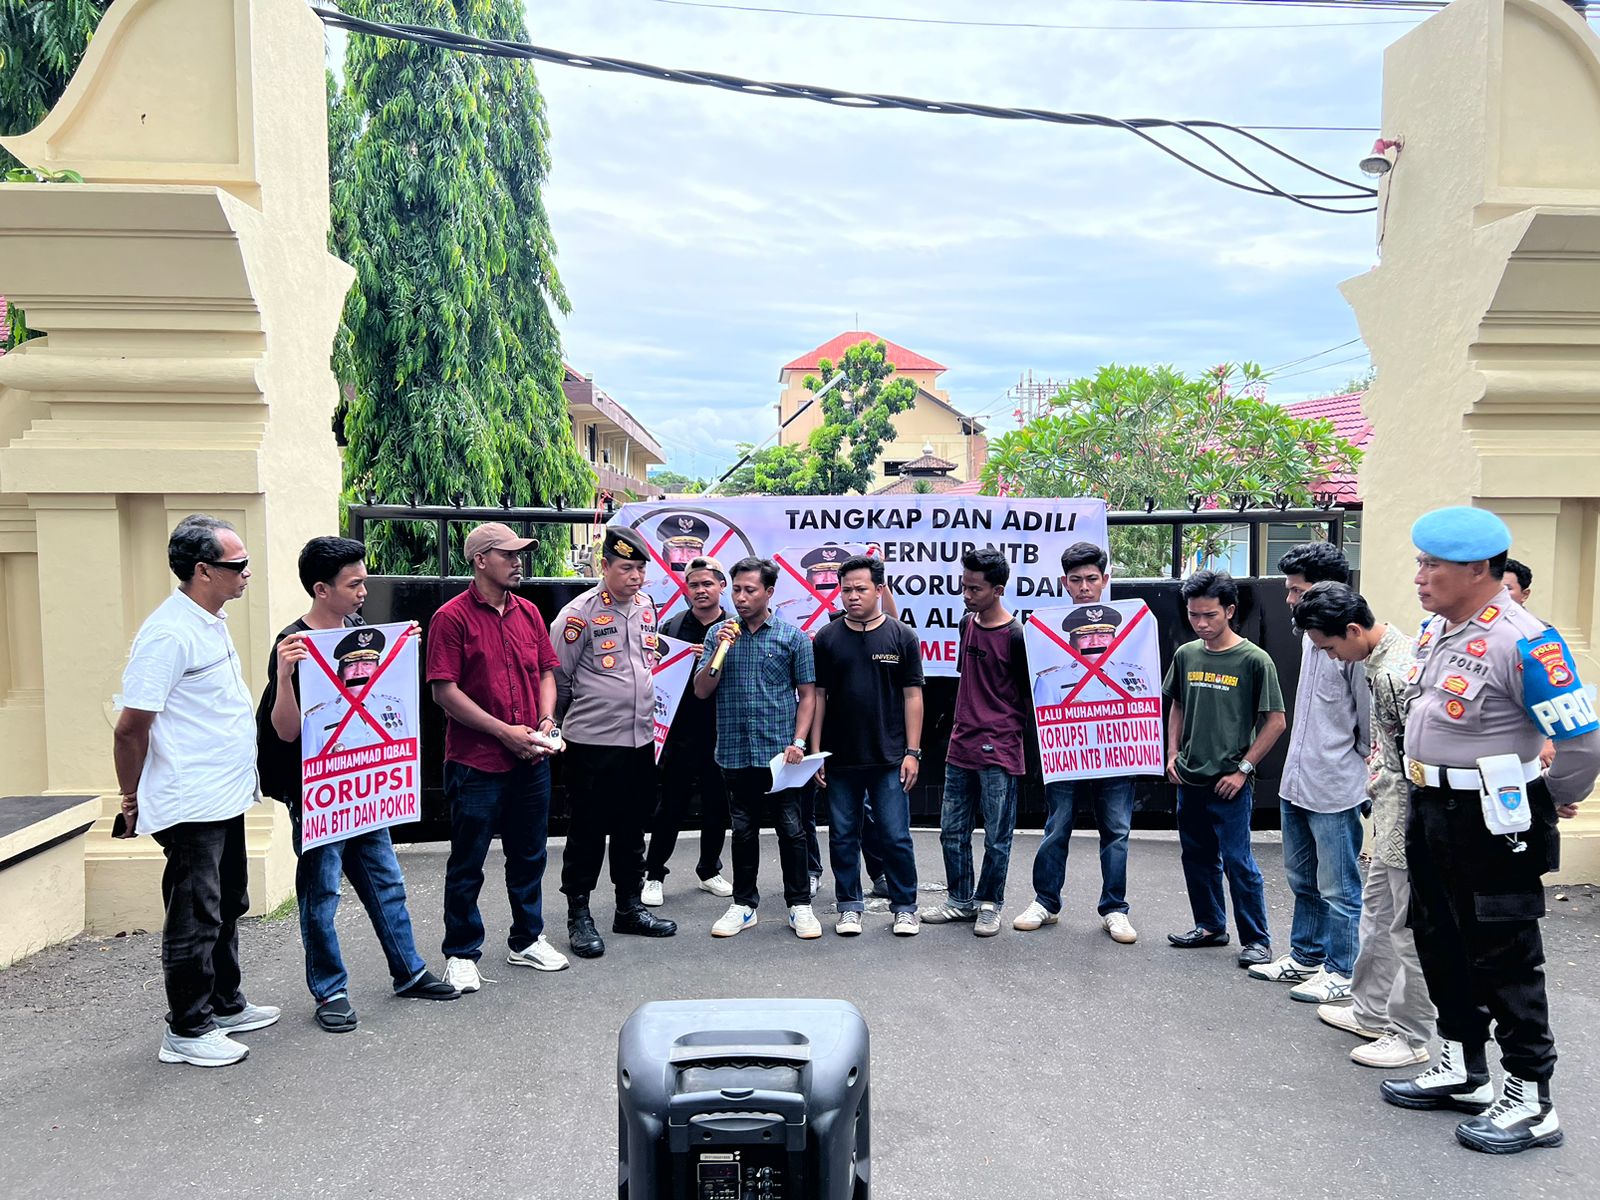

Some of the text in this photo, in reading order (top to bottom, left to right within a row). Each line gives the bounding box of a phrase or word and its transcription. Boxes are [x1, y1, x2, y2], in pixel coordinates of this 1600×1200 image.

[785, 508, 1077, 532] TANGKAP DAN ADILI
[1533, 643, 1560, 657] POLDA
[1449, 655, 1489, 677] POLRI
[1038, 701, 1157, 722] LALU MUHAMMAD IQBAL
[1040, 720, 1160, 750] KORUPSI MENDUNIA
[325, 748, 381, 773] MUHAMMAD
[383, 743, 413, 760] IQBAL
[1042, 744, 1162, 774] BUKAN NTB MENDUNIA
[304, 766, 413, 811] KORUPSI
[304, 793, 415, 842] ANA BTT DAN POKIR
